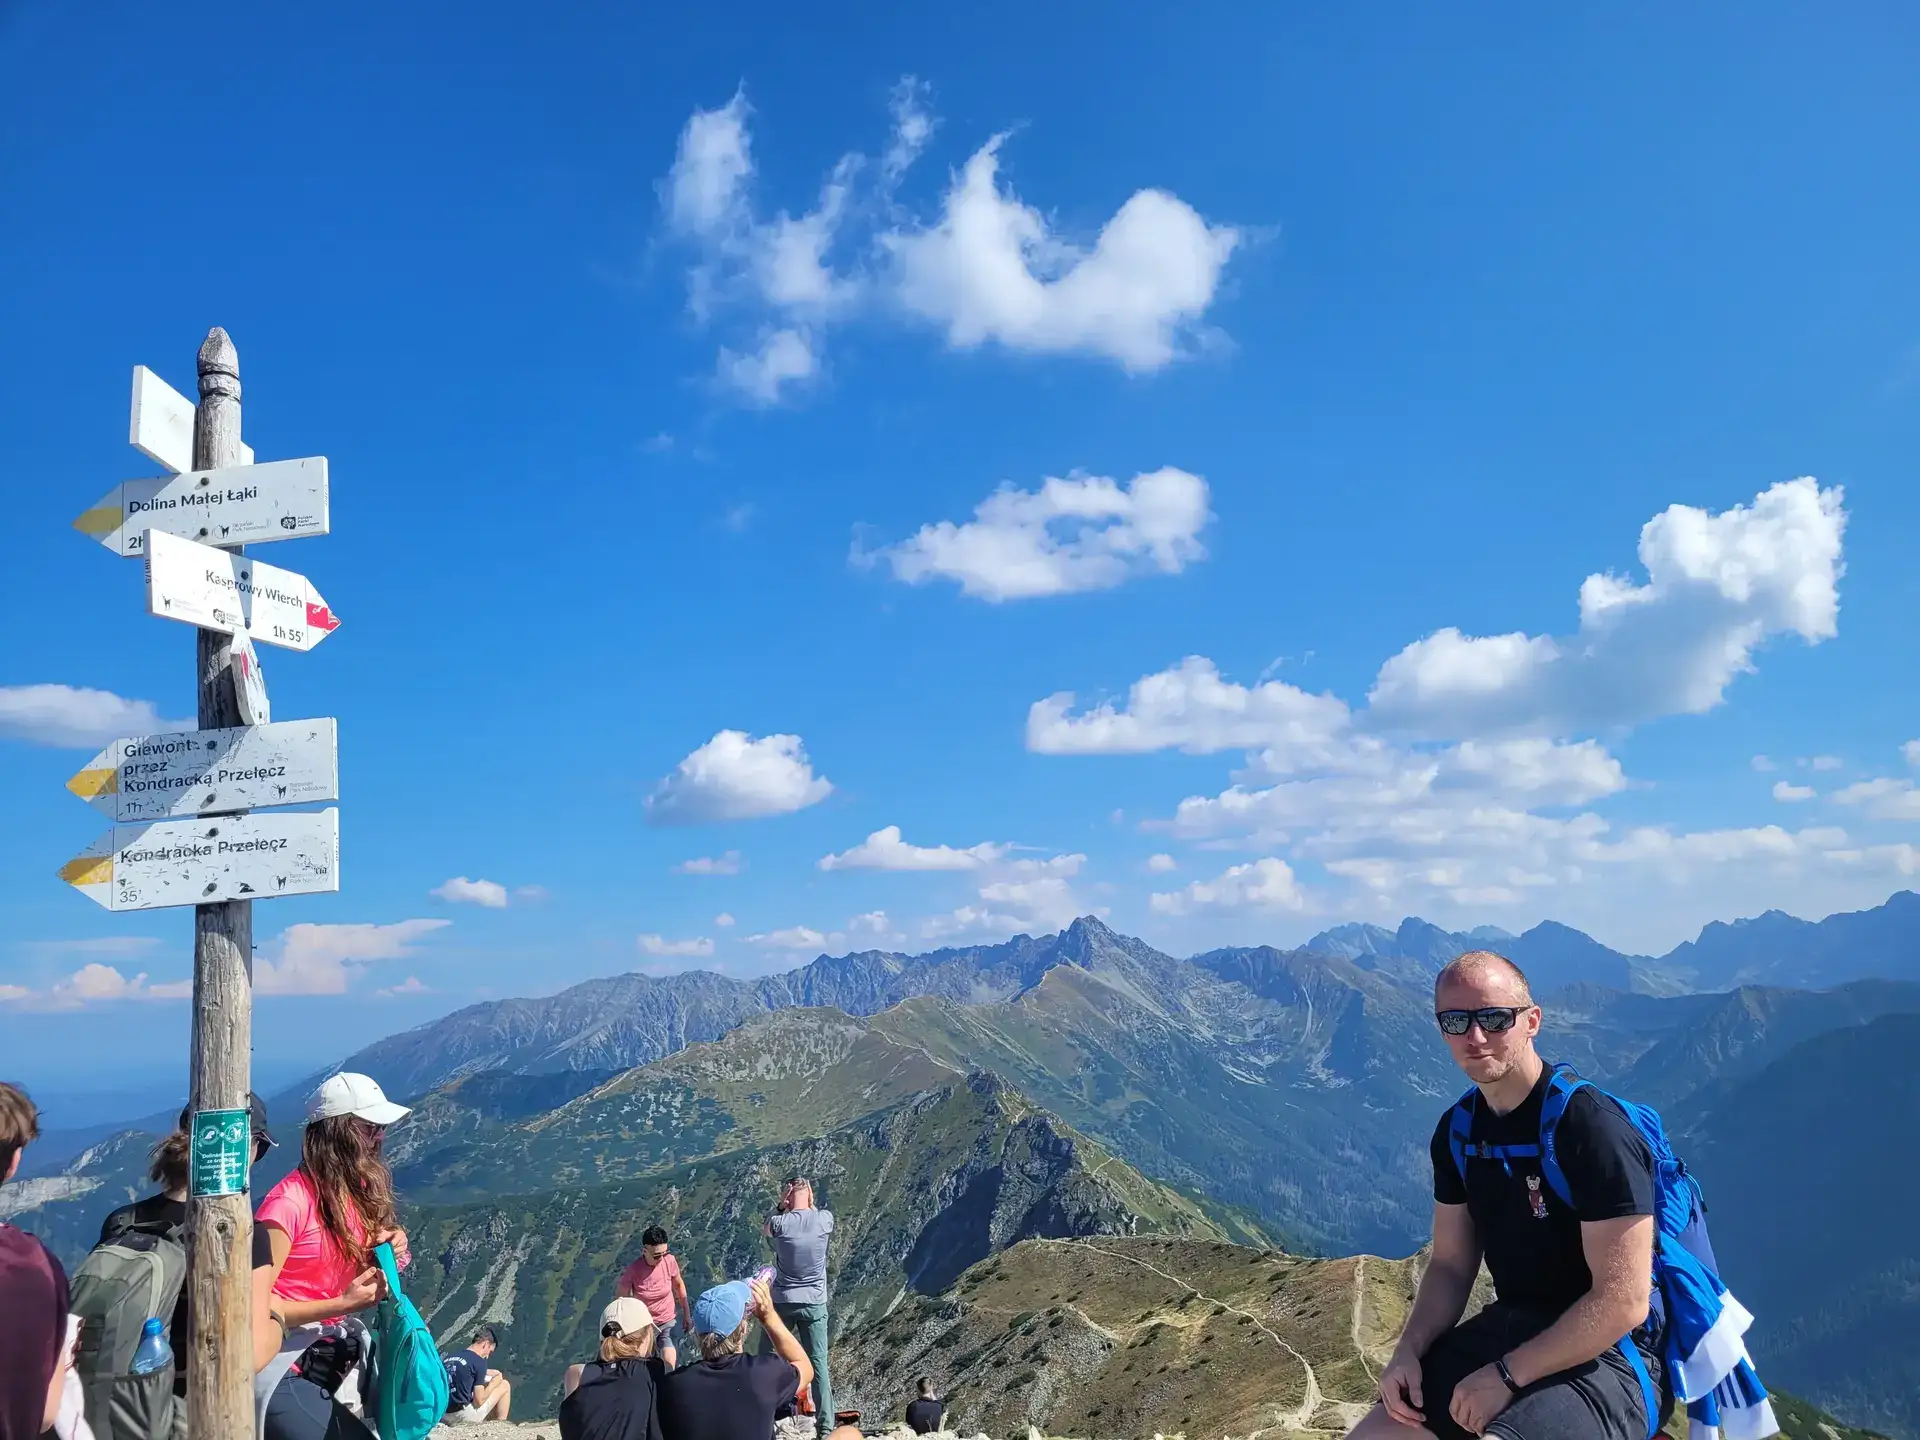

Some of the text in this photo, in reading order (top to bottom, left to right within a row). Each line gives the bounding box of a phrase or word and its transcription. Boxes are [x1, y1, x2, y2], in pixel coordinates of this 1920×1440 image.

[129, 486, 257, 513] Dolina Małej Łąki
[206, 569, 302, 608] Kasprowy Wierch
[273, 625, 286, 639] 1h
[124, 739, 191, 757] Giewont
[124, 762, 168, 778] przez
[124, 766, 286, 793] Kondracką Przełęcz
[120, 838, 288, 863] Kondracka Przełęcz
